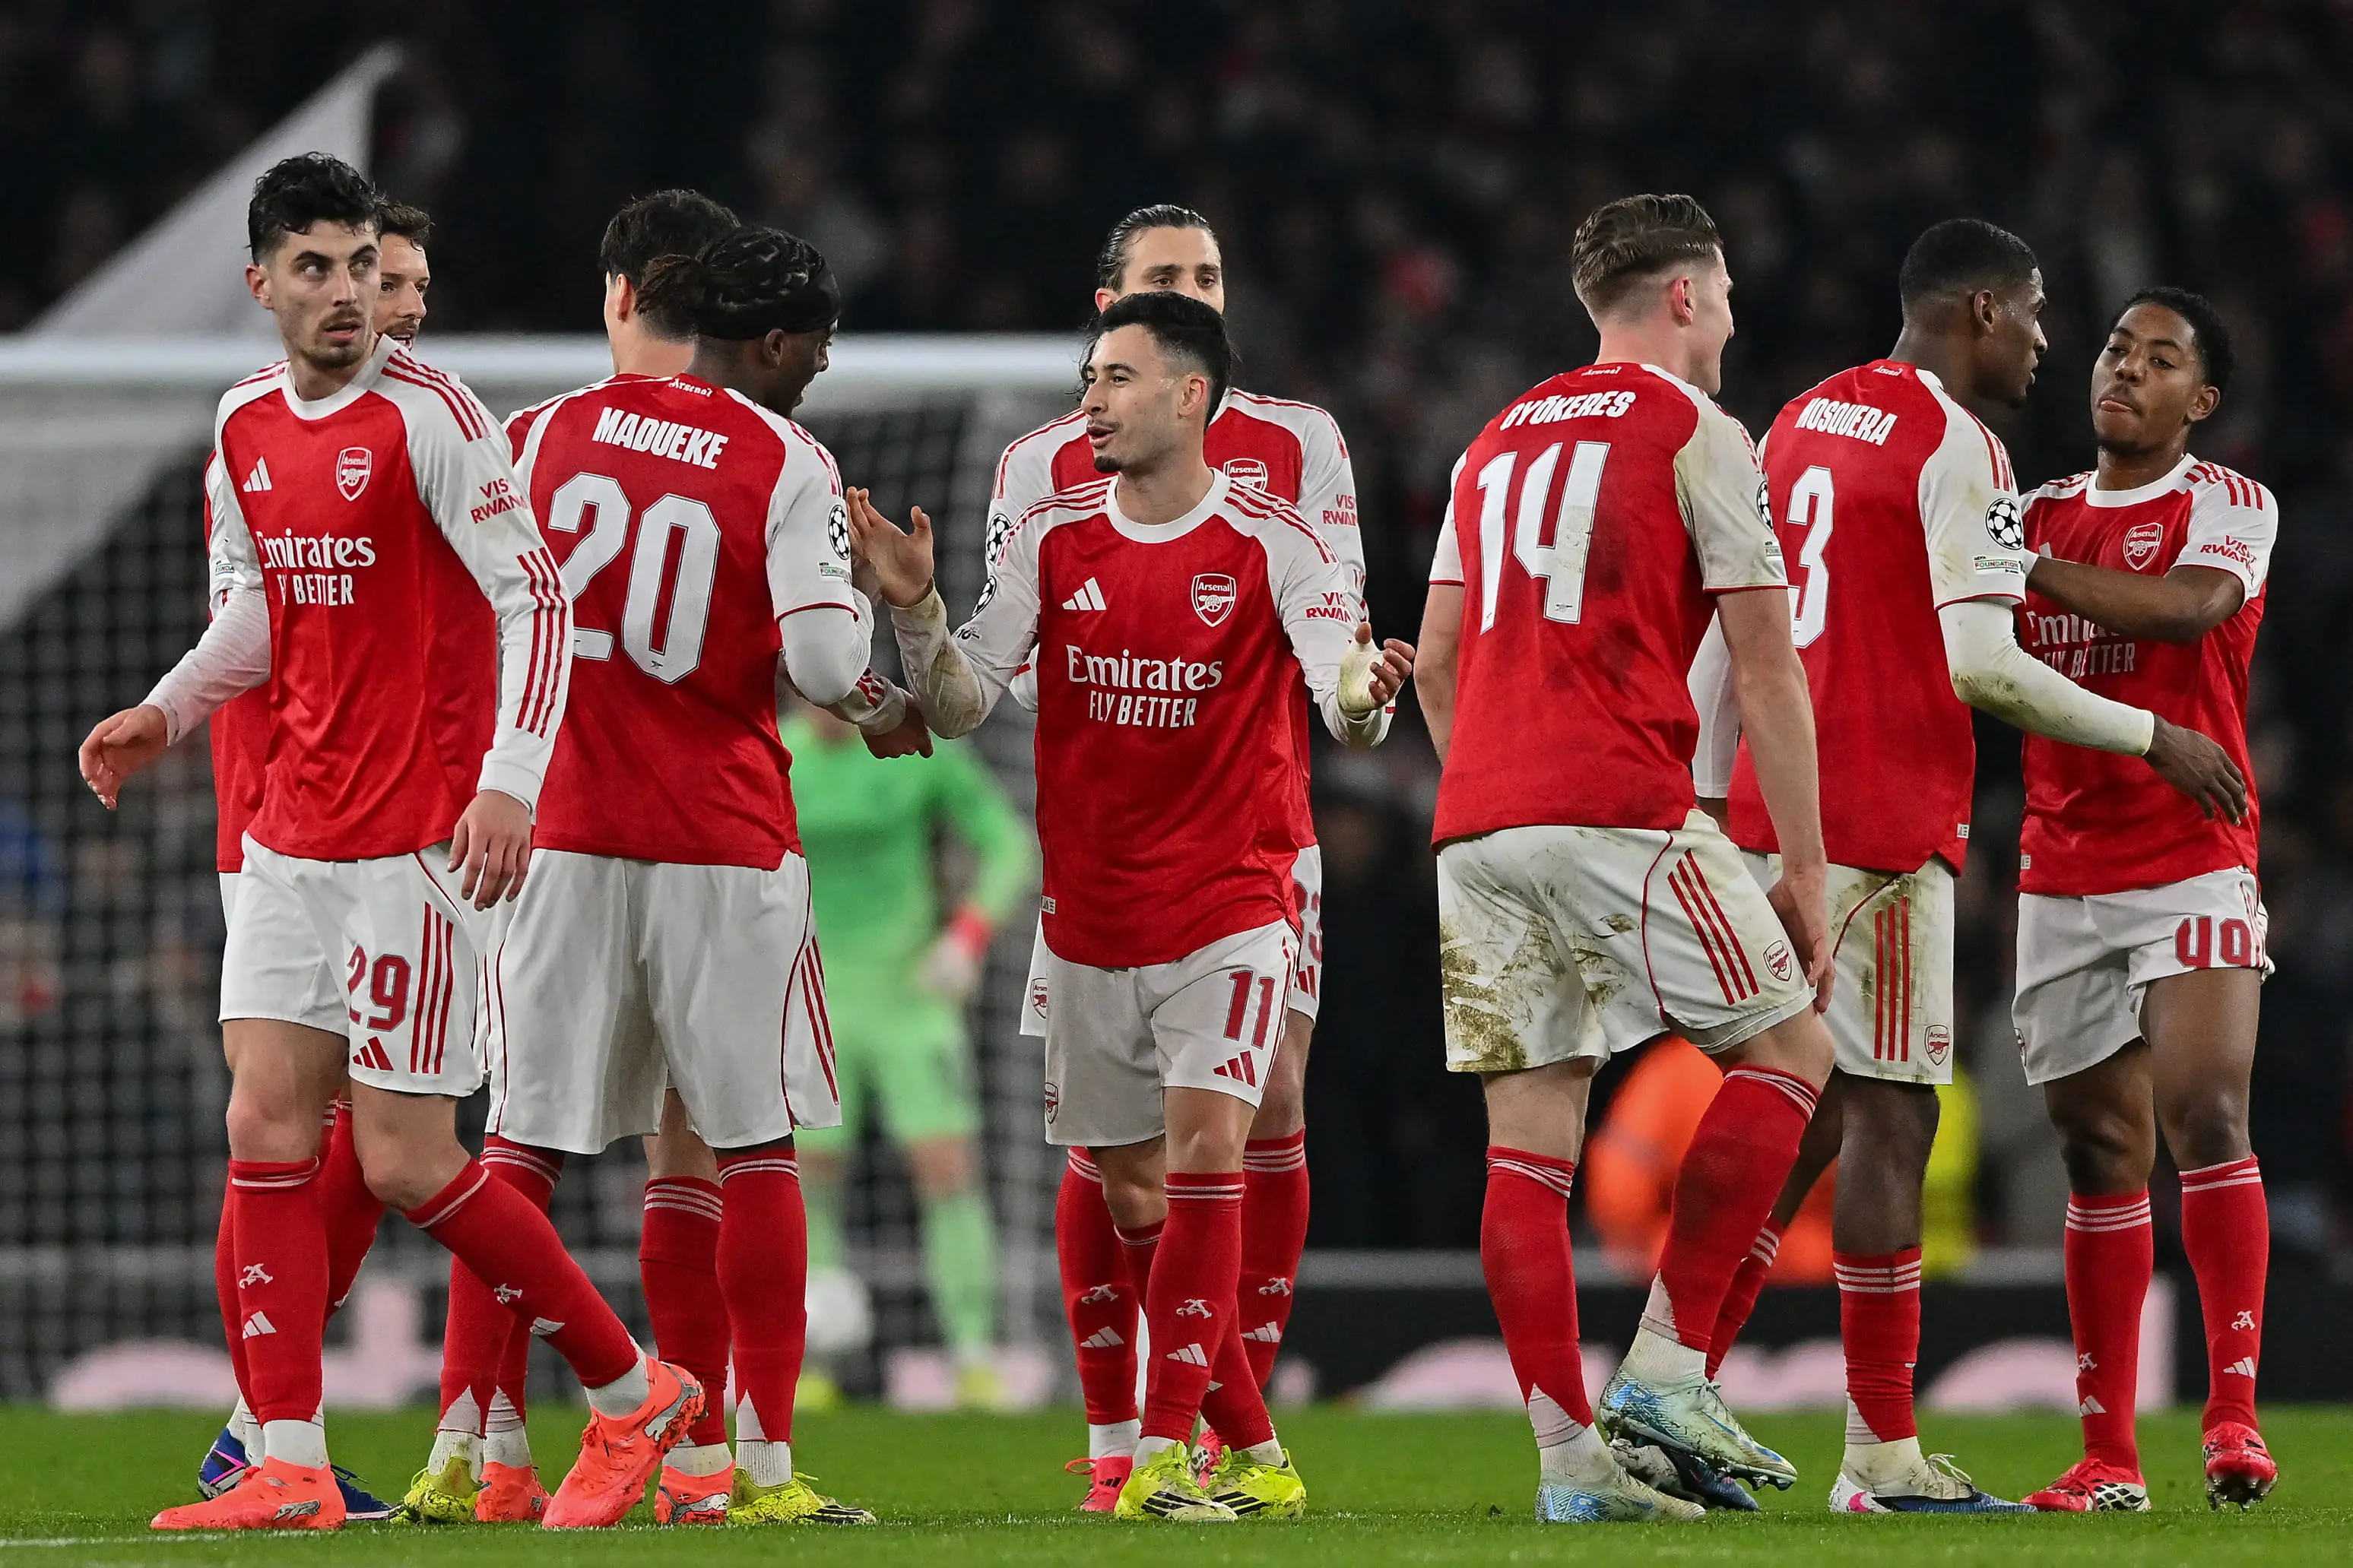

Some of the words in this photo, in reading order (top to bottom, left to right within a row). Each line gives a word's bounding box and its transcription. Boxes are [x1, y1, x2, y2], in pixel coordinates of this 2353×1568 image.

[591, 407, 729, 470] MADUEKE
[479, 477, 509, 499] VIS
[1336, 494, 1355, 510] VIS
[470, 495, 530, 524] RWAN
[1322, 510, 1356, 527] RWAN
[1476, 441, 1611, 635] 14
[2130, 530, 2158, 538] Arsenal
[1787, 465, 1835, 649] 3
[292, 574, 354, 607] BETTER
[549, 471, 721, 684] 20
[1197, 581, 1230, 592] Arsenal
[1305, 607, 1353, 623] RWAN
[1066, 644, 1224, 692] Emirates
[1089, 689, 1116, 723] FLY
[1116, 695, 1198, 729] BETTER
[347, 944, 411, 1033] 29
[1224, 971, 1276, 1051] 11
